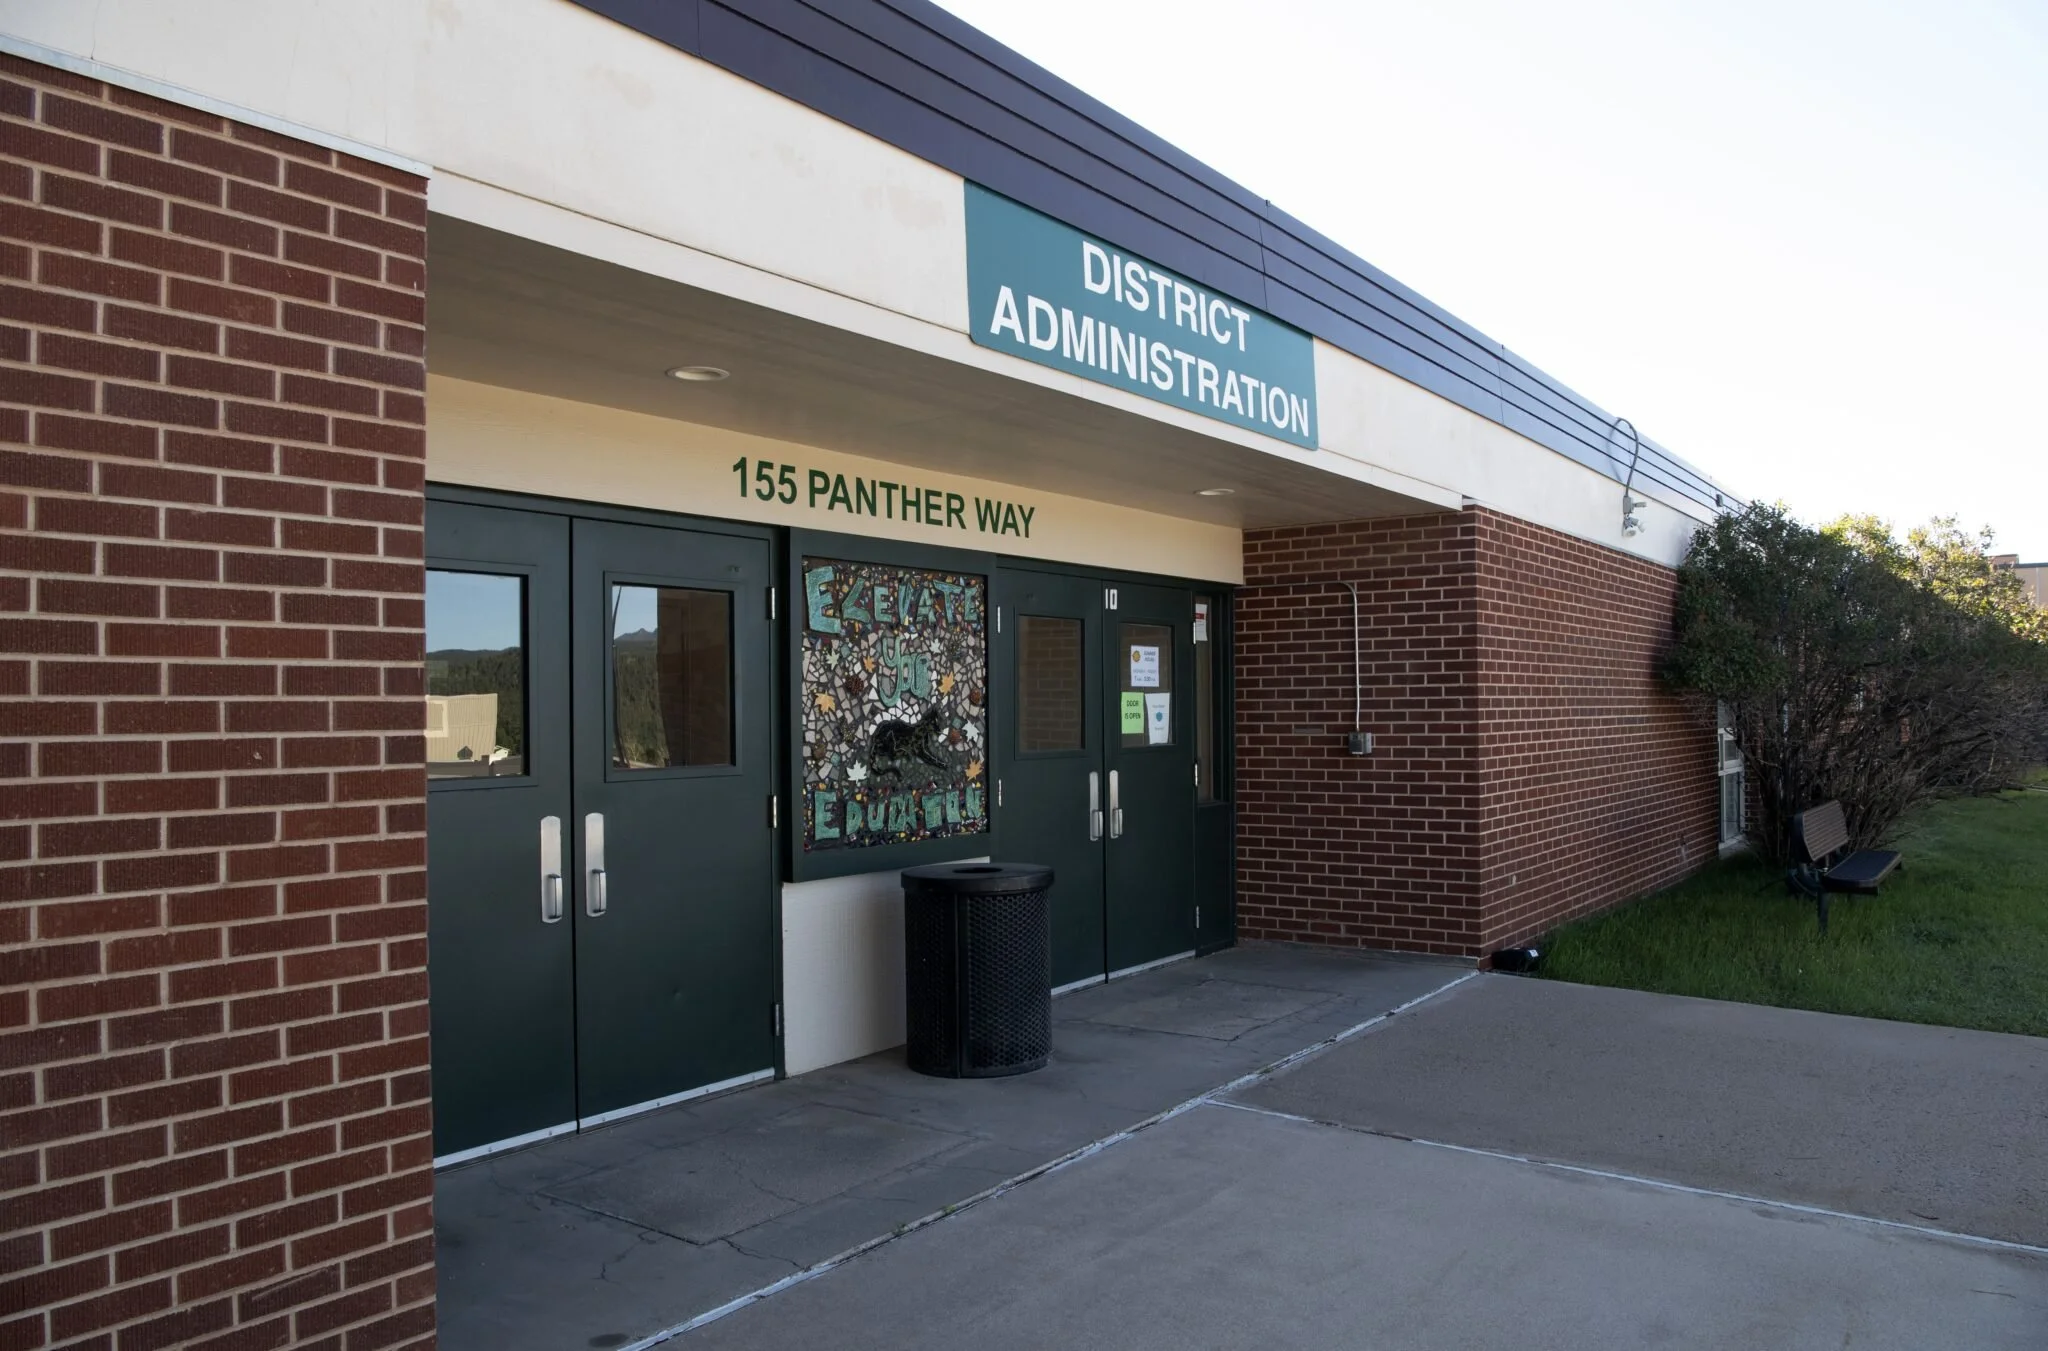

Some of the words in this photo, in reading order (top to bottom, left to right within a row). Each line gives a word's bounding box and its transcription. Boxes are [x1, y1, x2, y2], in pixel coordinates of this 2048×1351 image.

[1083, 241, 1250, 352] DISTRICT
[990, 285, 1309, 437] ADMINISTRATION
[733, 457, 797, 504] 155
[809, 469, 967, 530] PANTHER
[975, 497, 1035, 538] WAY
[805, 566, 979, 634] ELEVATE
[1105, 588, 1118, 610] 10
